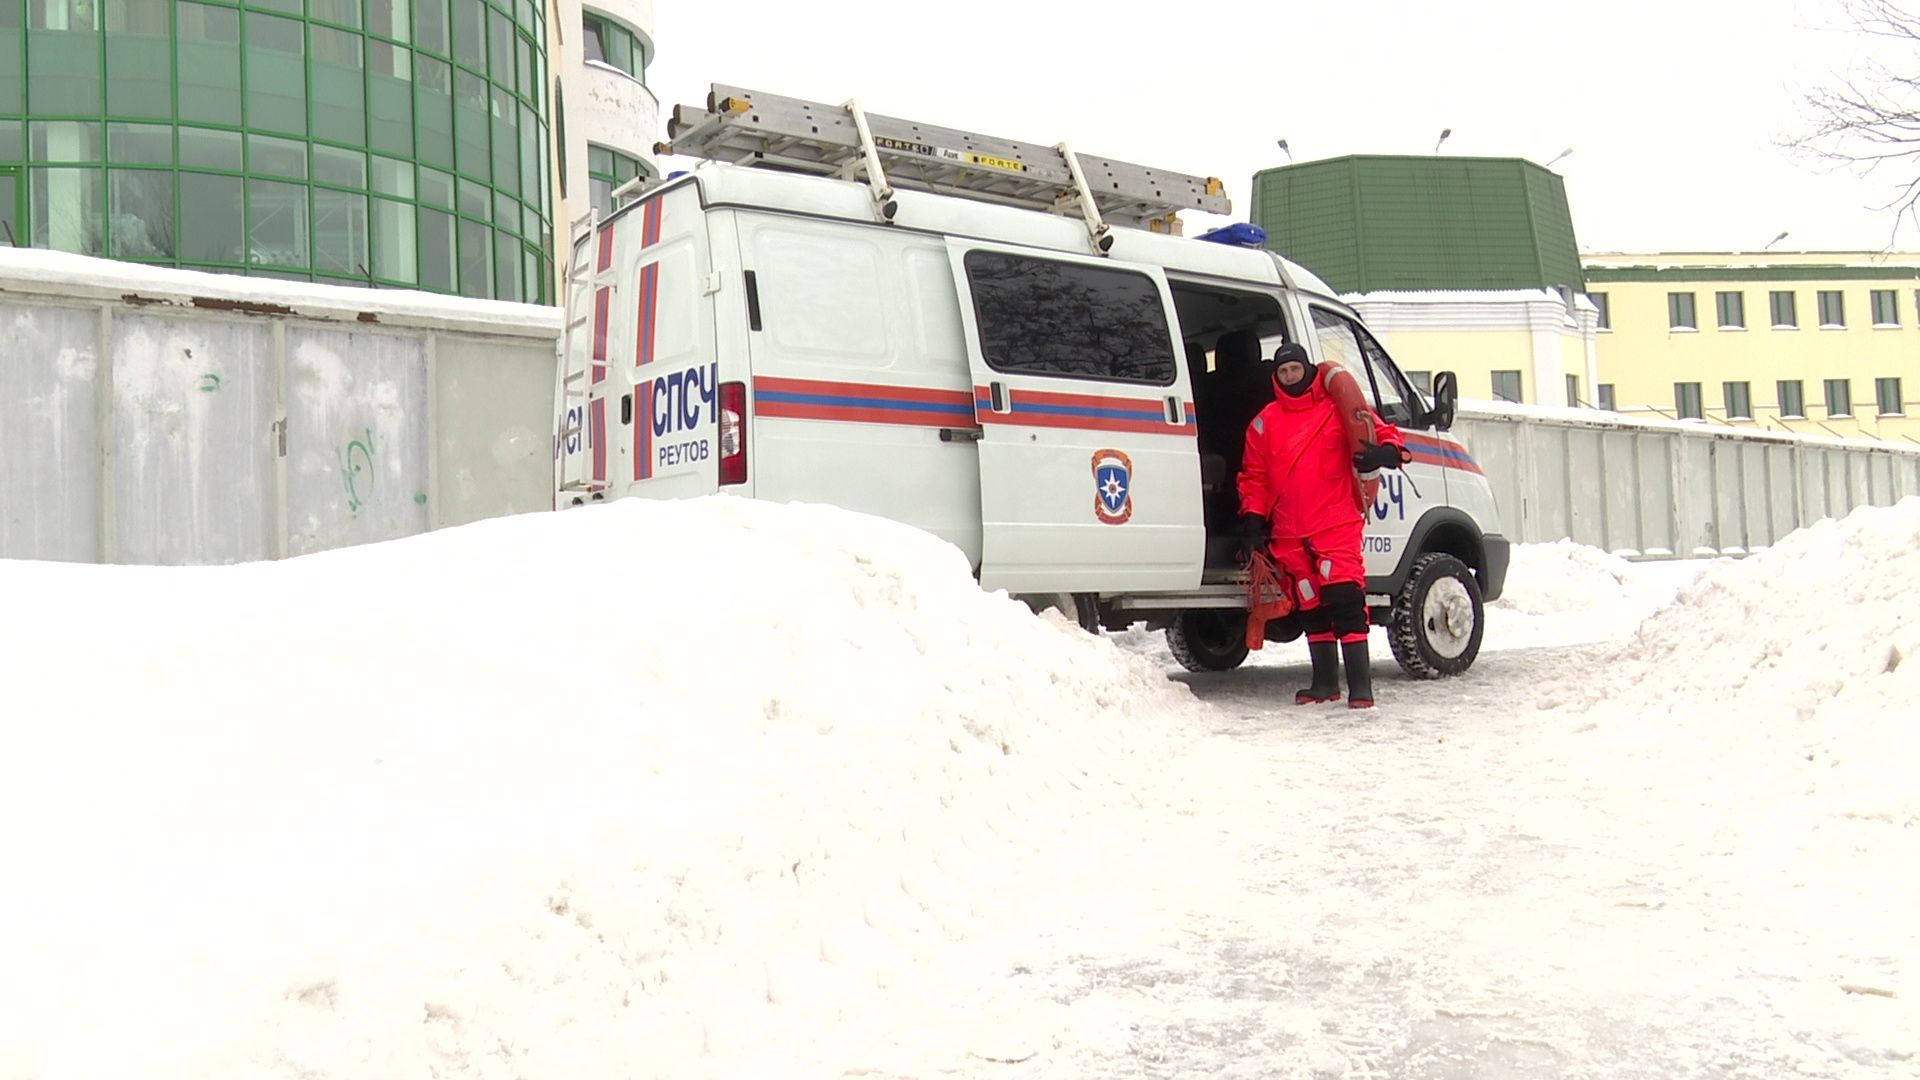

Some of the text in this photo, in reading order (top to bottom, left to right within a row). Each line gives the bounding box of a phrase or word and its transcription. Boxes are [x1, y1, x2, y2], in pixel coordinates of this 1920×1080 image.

[980, 157, 1020, 170] FORTE
[652, 362, 717, 438] СПСЧ
[659, 439, 709, 467] РЕУТОВ
[1374, 474, 1404, 520] СЧ
[1362, 537, 1391, 553] УТОВ
